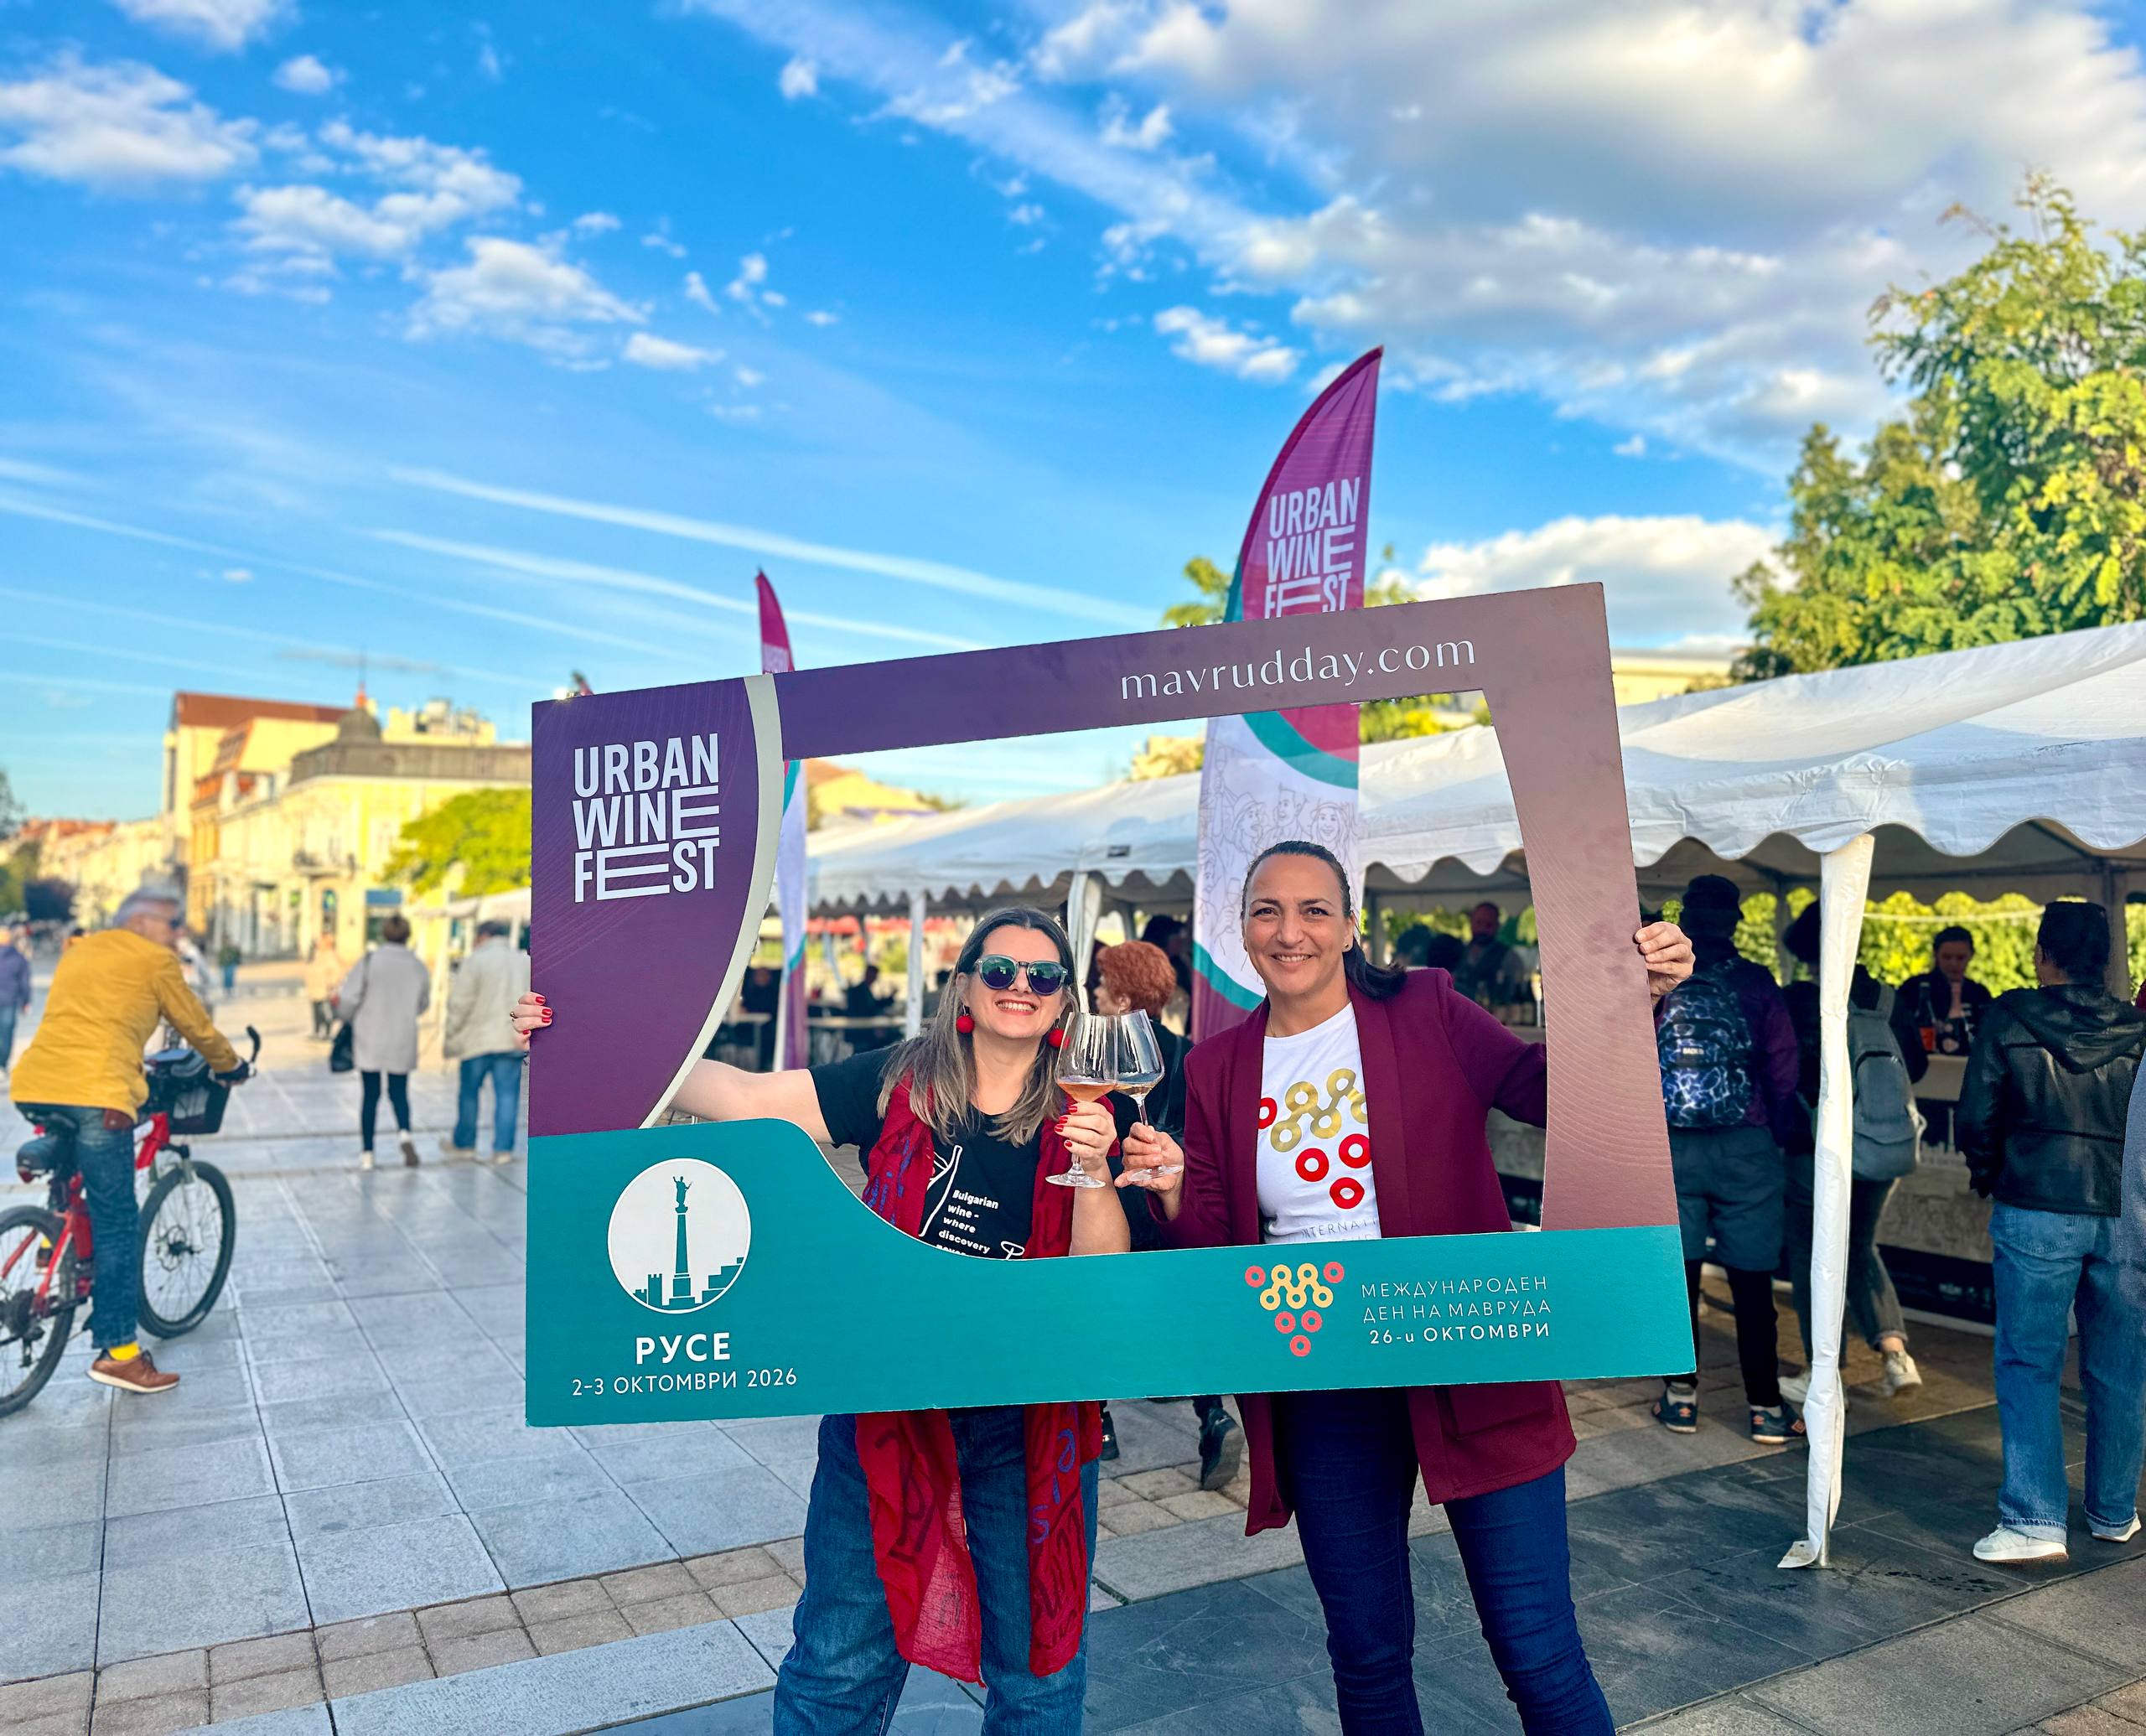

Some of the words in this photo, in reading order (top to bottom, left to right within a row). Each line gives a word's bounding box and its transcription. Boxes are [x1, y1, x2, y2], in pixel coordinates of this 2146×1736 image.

[1268, 476, 1360, 539] URBAN
[1266, 524, 1355, 583] WINE
[1121, 639, 1475, 700] mavrudday.com
[573, 733, 719, 798] URBAN
[572, 785, 720, 850] WINE
[573, 837, 720, 903] FEST
[947, 1205, 972, 1219] wine
[951, 1189, 999, 1210] Bulgarian
[943, 1216, 976, 1234] where
[938, 1230, 991, 1254] discovery
[1361, 1276, 1547, 1298] МЕЖДУНАРОДЕН
[1363, 1305, 1404, 1324] ДЕН
[1413, 1304, 1441, 1319] НА
[1449, 1299, 1551, 1317] МАВРУДА
[1423, 1322, 1549, 1342] ОКТОМВРИ
[636, 1332, 730, 1365] РУСЕ
[573, 1378, 604, 1396] 2-3
[614, 1371, 737, 1394] ОКТОМВРИ
[747, 1367, 797, 1387] 2026
